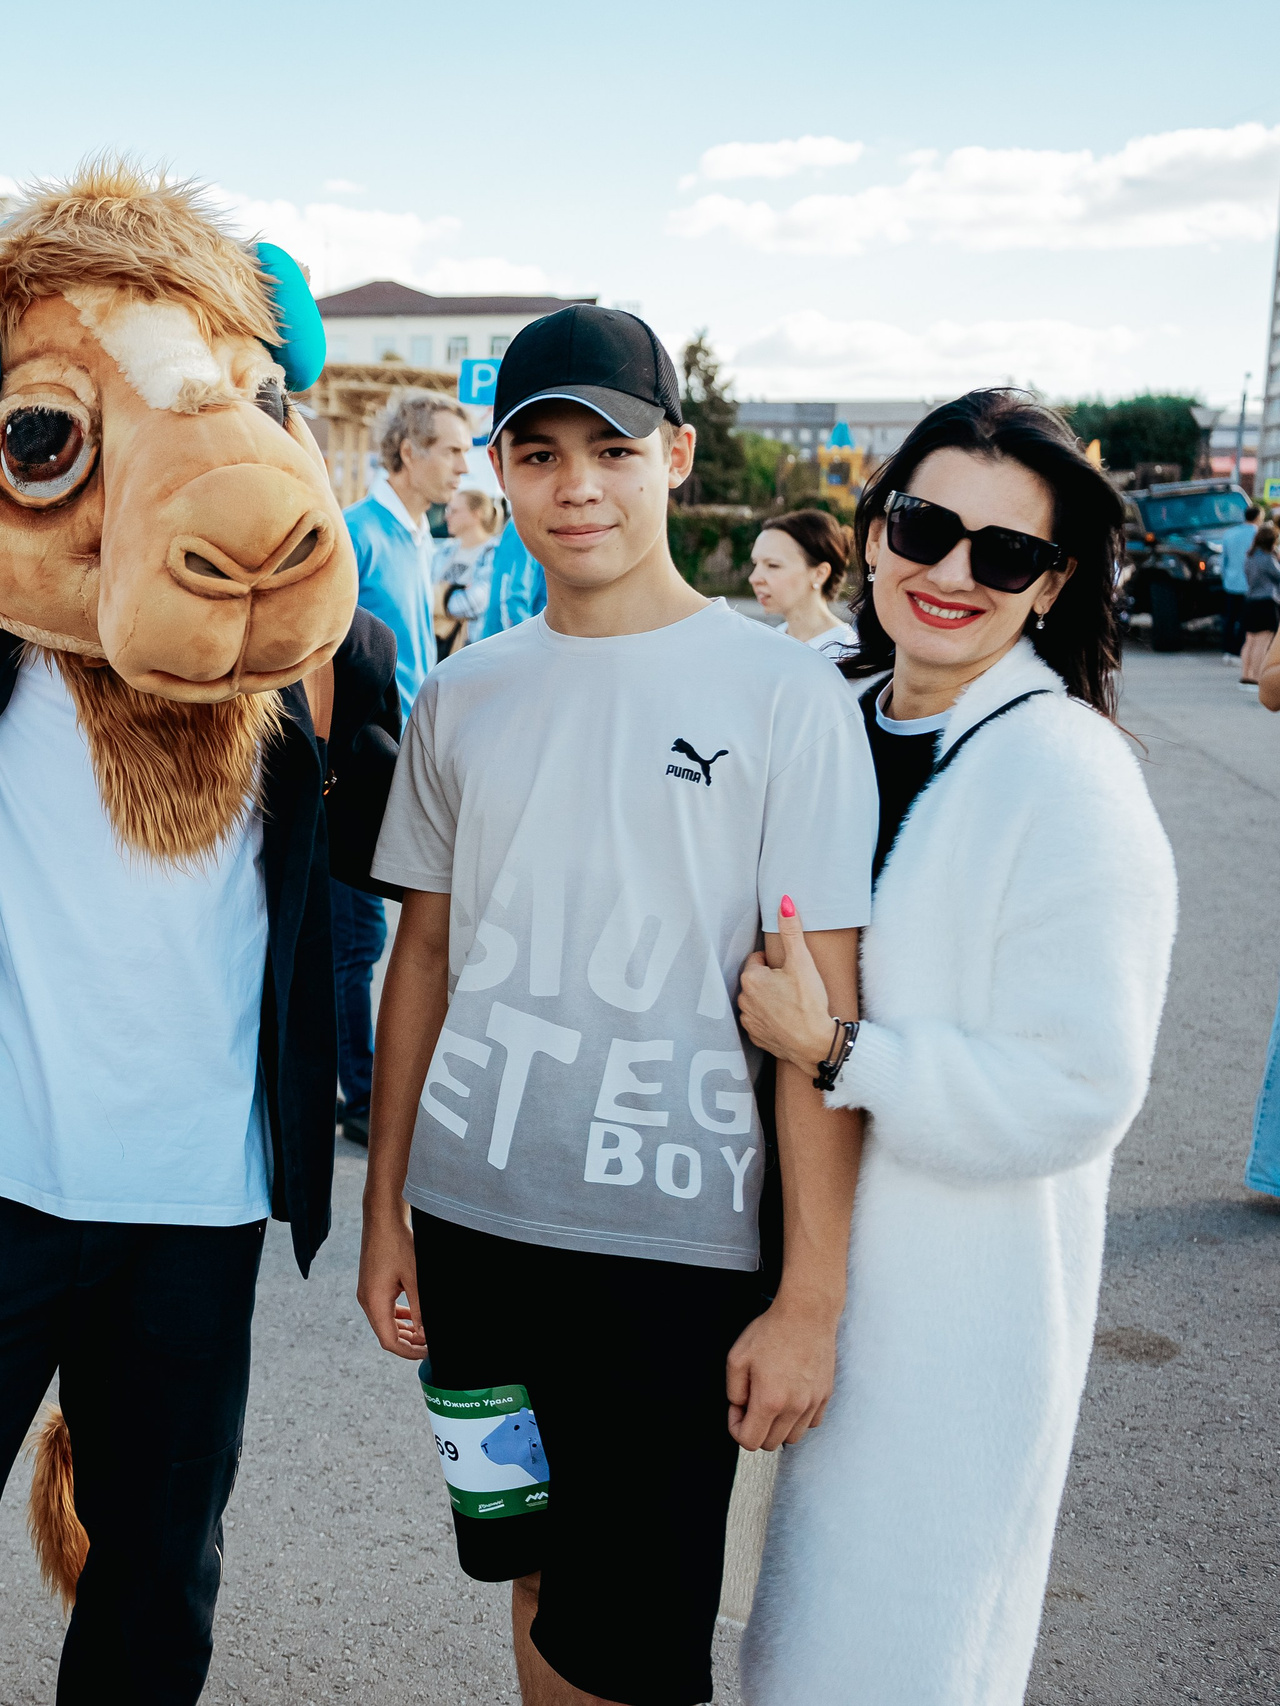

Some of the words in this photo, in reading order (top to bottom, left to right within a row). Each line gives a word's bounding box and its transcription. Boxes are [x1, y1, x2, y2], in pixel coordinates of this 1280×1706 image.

[472, 363, 497, 398] P
[665, 764, 702, 784] PUMA
[583, 1121, 757, 1213] BOY
[442, 1400, 480, 1408] Южного
[482, 1396, 513, 1407] Урала
